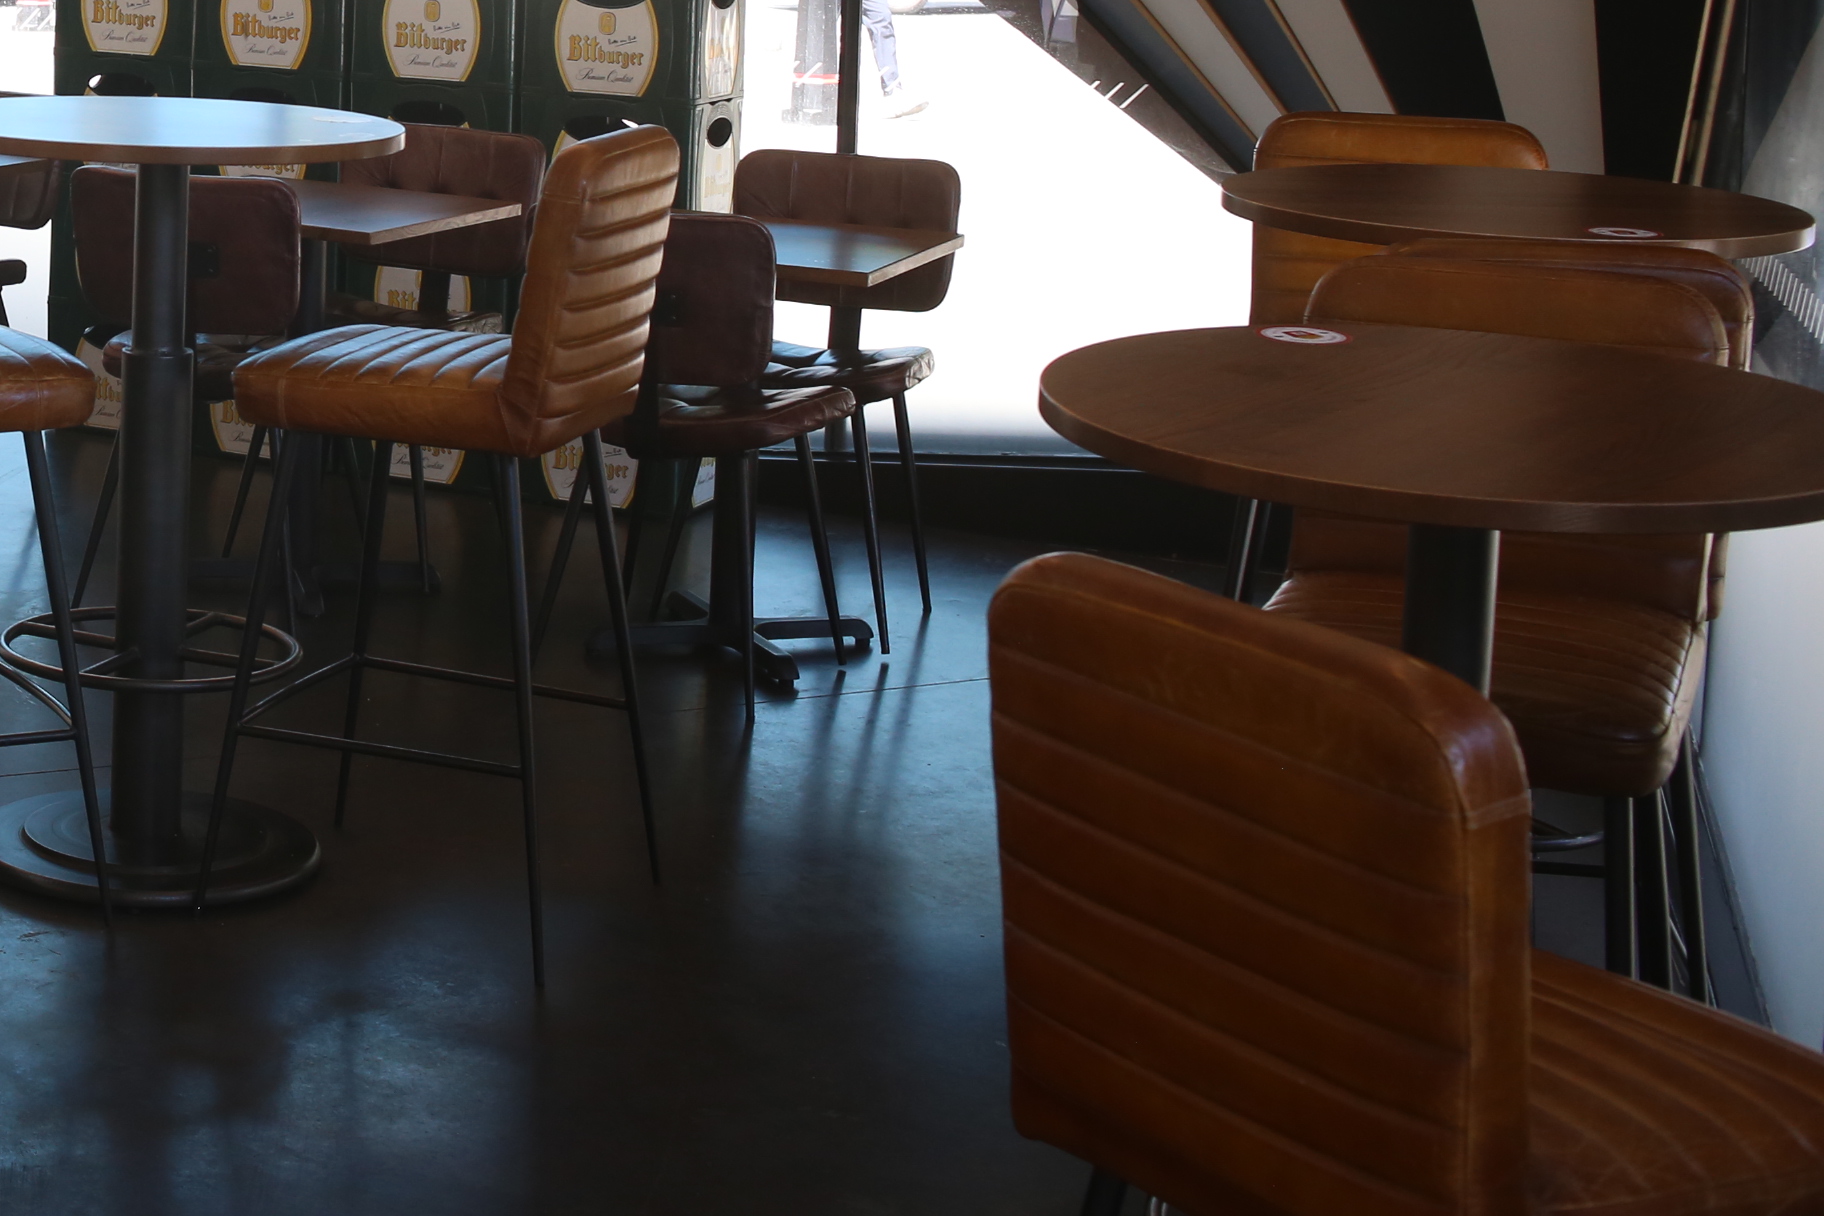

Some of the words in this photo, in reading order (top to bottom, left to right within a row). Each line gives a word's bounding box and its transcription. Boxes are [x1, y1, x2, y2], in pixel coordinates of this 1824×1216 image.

[231, 11, 301, 44] Bitburger
[393, 21, 467, 56] Bitburger
[566, 34, 644, 70] Bitburger
